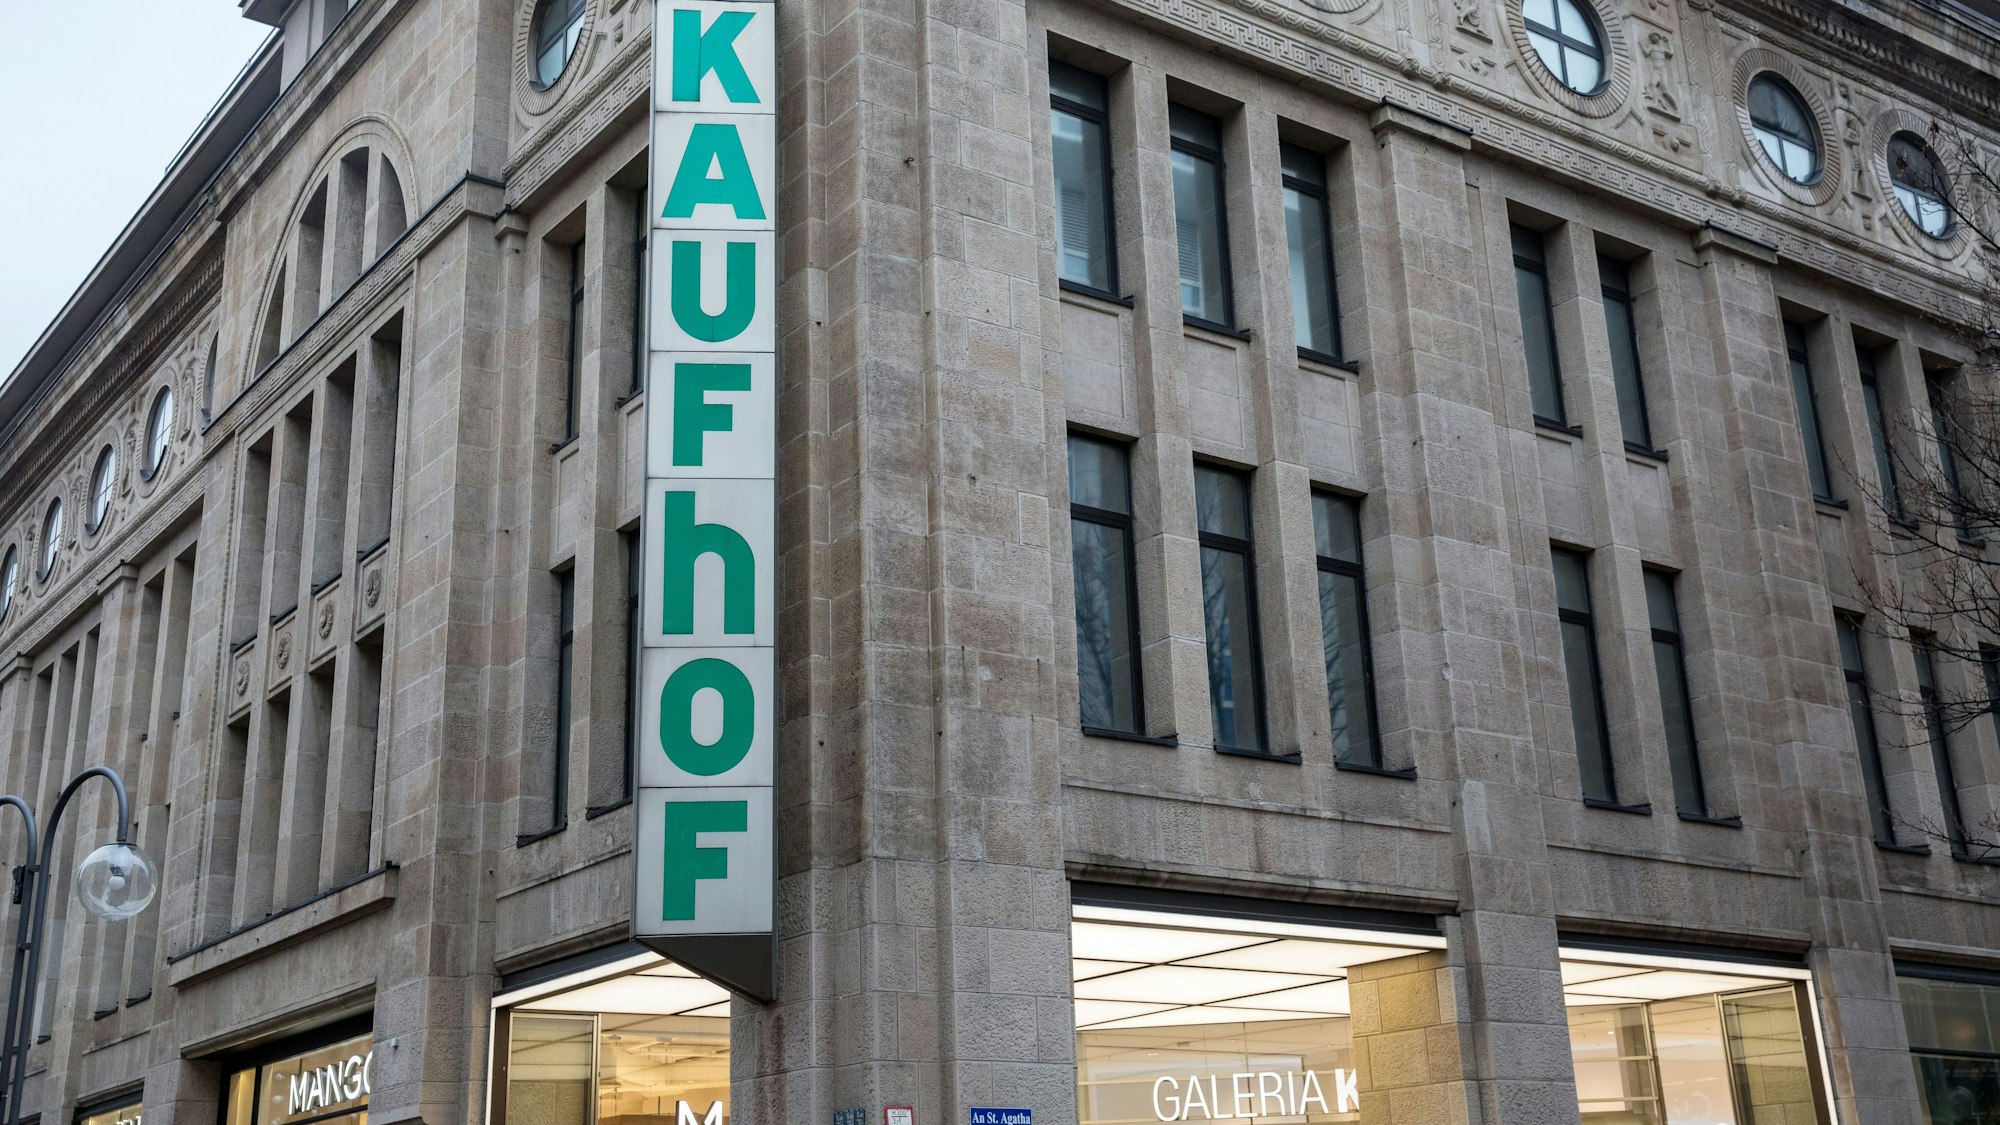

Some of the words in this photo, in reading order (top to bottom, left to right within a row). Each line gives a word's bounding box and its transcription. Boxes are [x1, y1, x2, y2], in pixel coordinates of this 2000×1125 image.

[1153, 1069, 1329, 1122] GALERIA
[972, 1111, 985, 1124] An
[986, 1111, 999, 1124] St.
[1000, 1112, 1031, 1125] Agatha
